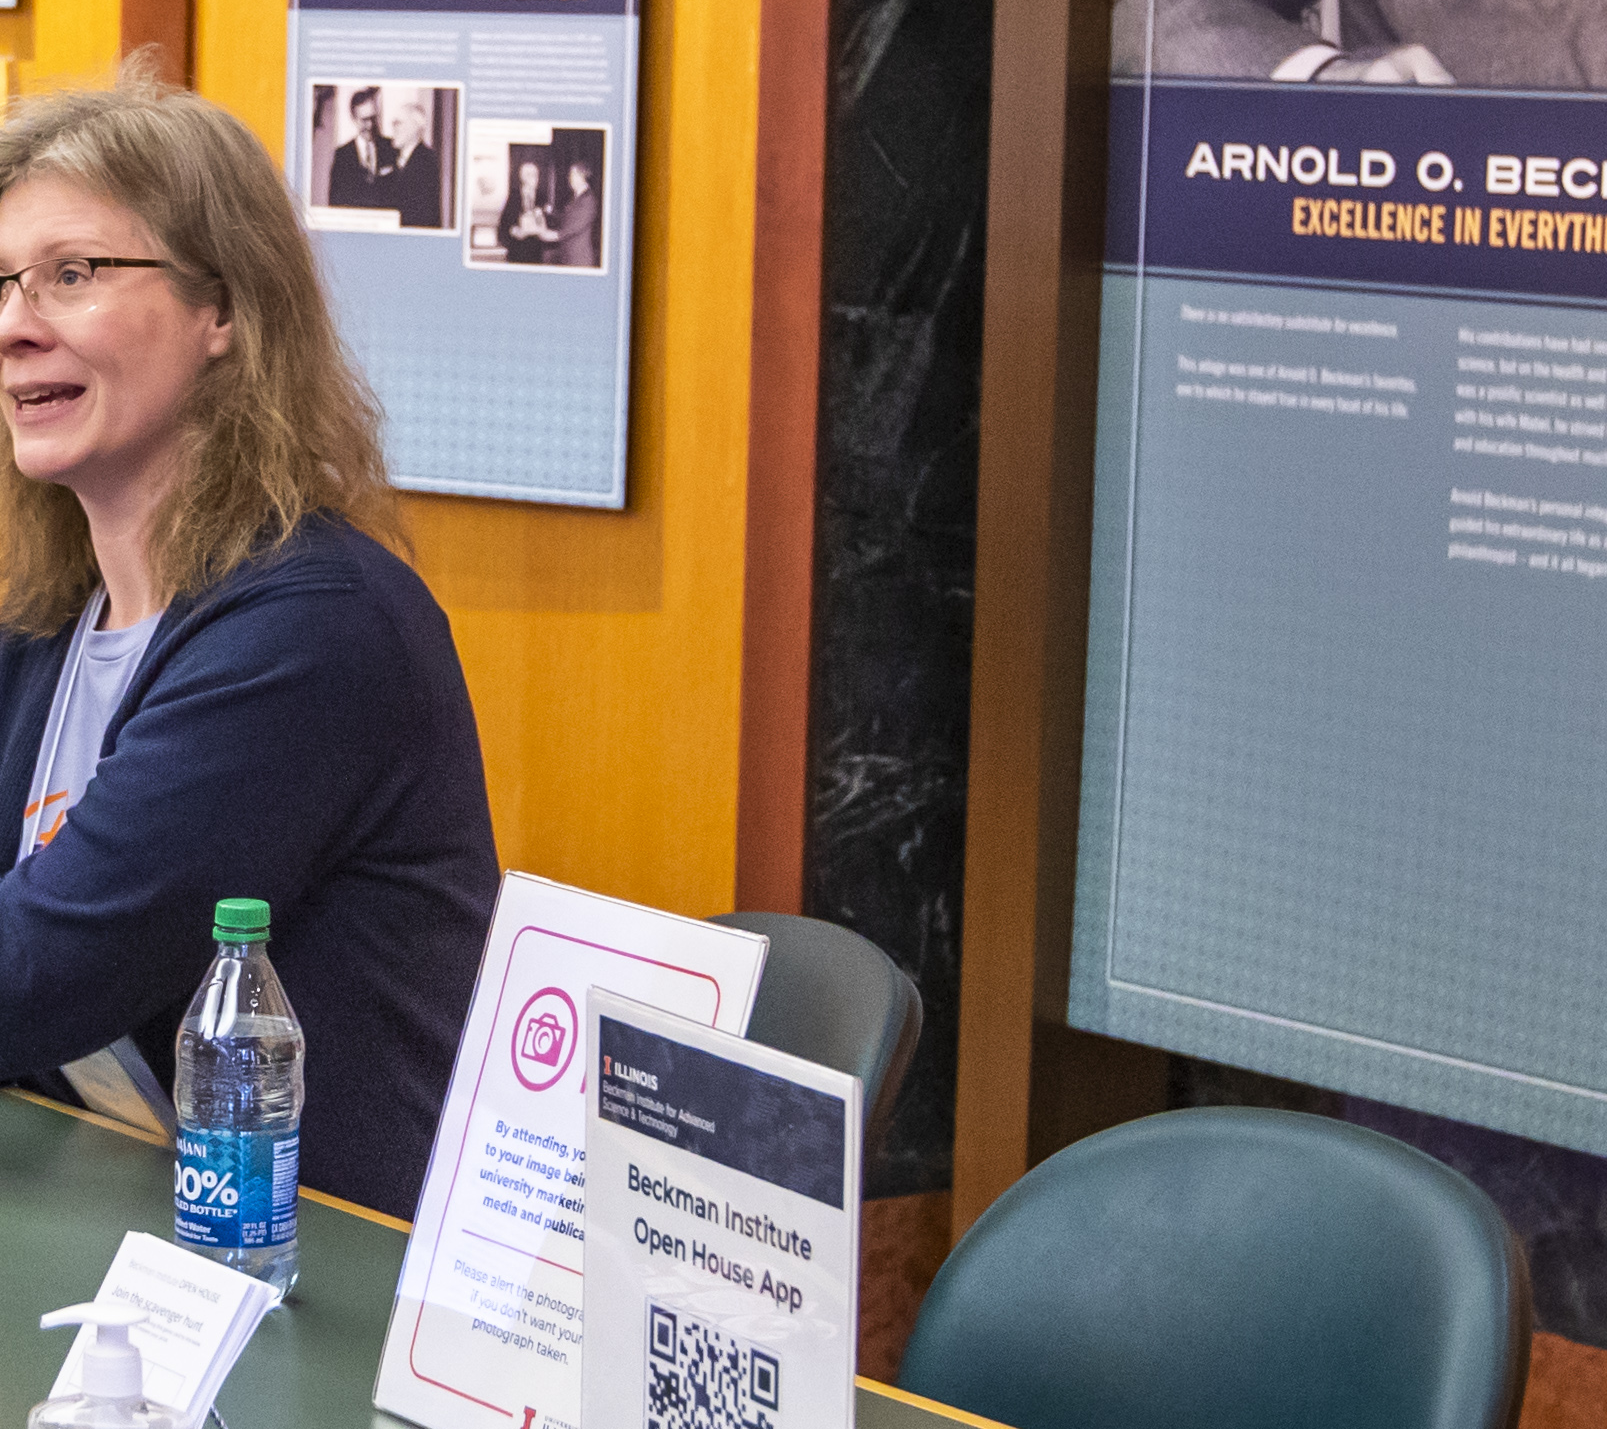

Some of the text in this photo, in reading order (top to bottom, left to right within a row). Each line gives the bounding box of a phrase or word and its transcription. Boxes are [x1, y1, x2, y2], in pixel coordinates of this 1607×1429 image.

[1186, 142, 1395, 186] ARNOLD
[1417, 151, 1463, 192] O.
[1292, 197, 1446, 244] EXCELLENCE
[1455, 206, 1482, 244] IN
[615, 1062, 658, 1091] ILLINOIS
[603, 1080, 715, 1133] Beckman Institute for Advanced
[603, 1097, 678, 1138] Science & Technology
[496, 1120, 585, 1161] By attending, yo
[485, 1143, 585, 1187] to your image bein
[480, 1168, 585, 1214] university marketin
[628, 1163, 812, 1260] Beckman Institute
[483, 1196, 585, 1240] media and publica
[634, 1217, 802, 1313] Open House App
[112, 1285, 204, 1332] Join the scavenger hunt
[179, 1279, 198, 1293] OPEN
[199, 1288, 221, 1303] HOUSE
[454, 1259, 583, 1321] Please alert the photogra
[470, 1289, 583, 1345] if you don't want your
[472, 1318, 568, 1365] photograph taken.
